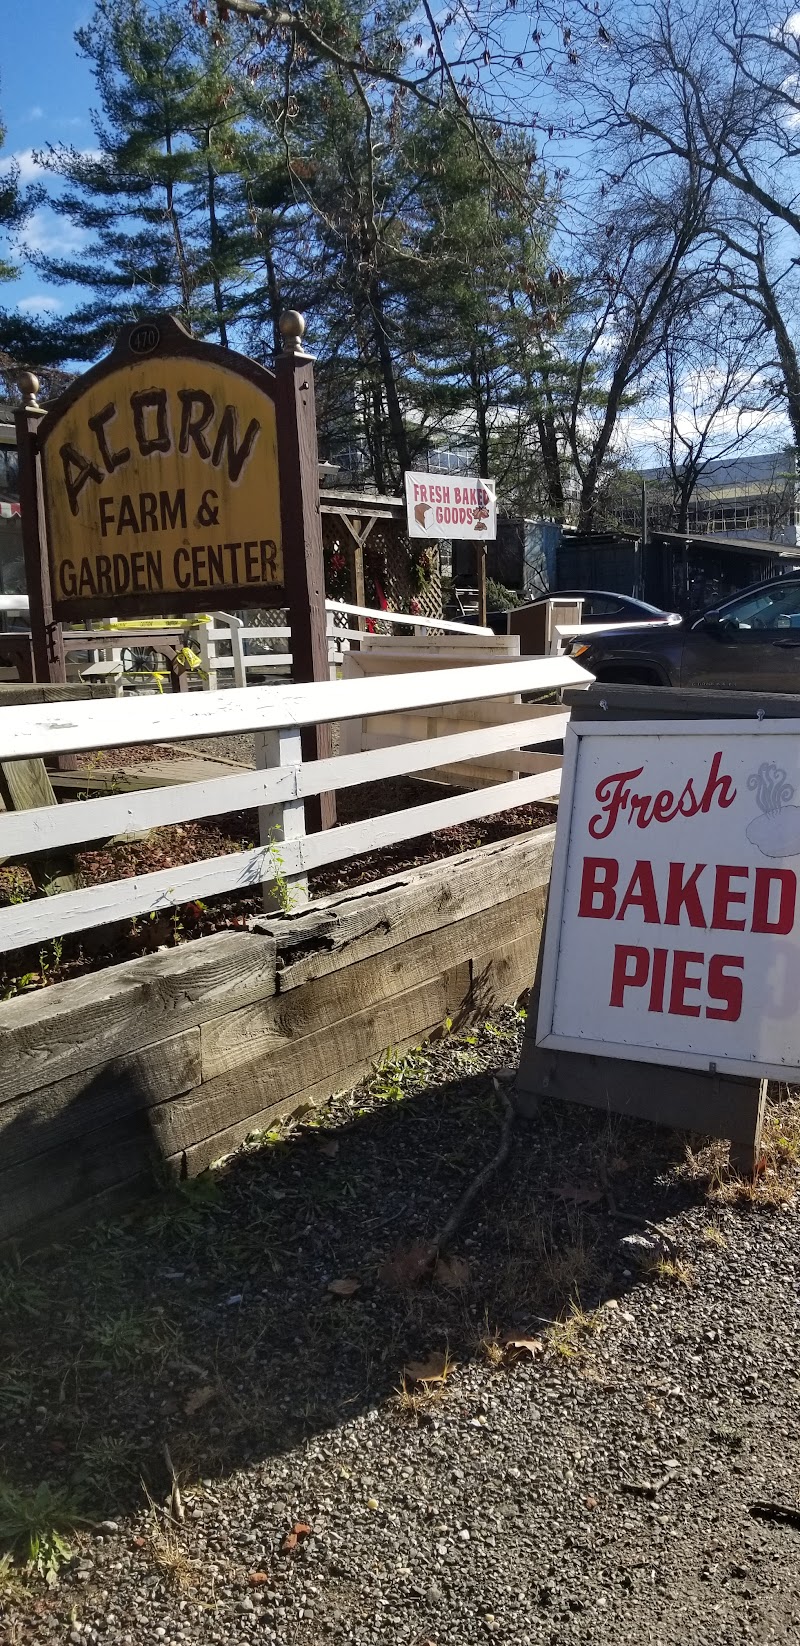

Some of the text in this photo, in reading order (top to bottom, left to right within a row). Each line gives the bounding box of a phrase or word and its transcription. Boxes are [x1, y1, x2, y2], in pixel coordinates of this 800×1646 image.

[59, 386, 261, 517] ACORN
[100, 488, 220, 537] FARM &
[413, 483, 490, 506] FRESH BAKED
[435, 506, 474, 525] GOODS
[59, 539, 279, 597] GARDEN CENTER
[588, 751, 737, 840] Fresh
[577, 856, 797, 935] BAKED
[608, 943, 745, 1022] PIES
